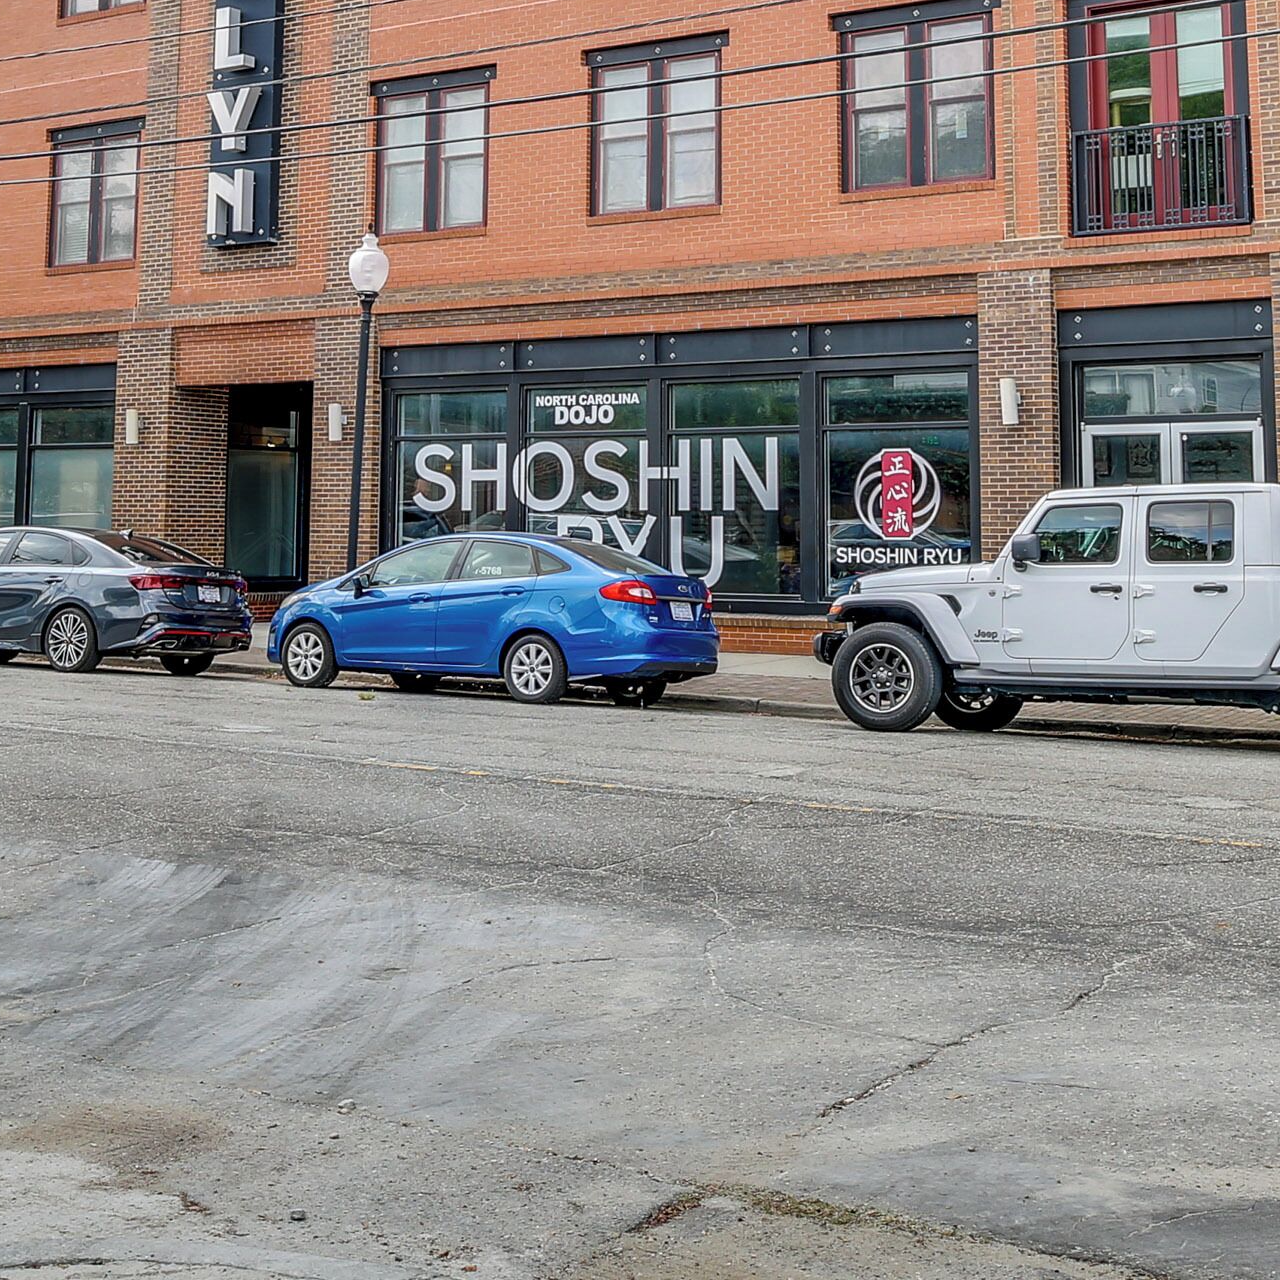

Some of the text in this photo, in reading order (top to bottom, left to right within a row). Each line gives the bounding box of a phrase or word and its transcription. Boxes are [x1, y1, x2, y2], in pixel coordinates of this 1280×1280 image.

[535, 393, 640, 407] NORTH CAROLINA
[554, 405, 614, 425] DOJO
[413, 436, 779, 512] SHOSHIN
[883, 456, 910, 532] 正心流
[836, 547, 962, 565] SHOSHIN RYU
[974, 629, 998, 639] Jeep
